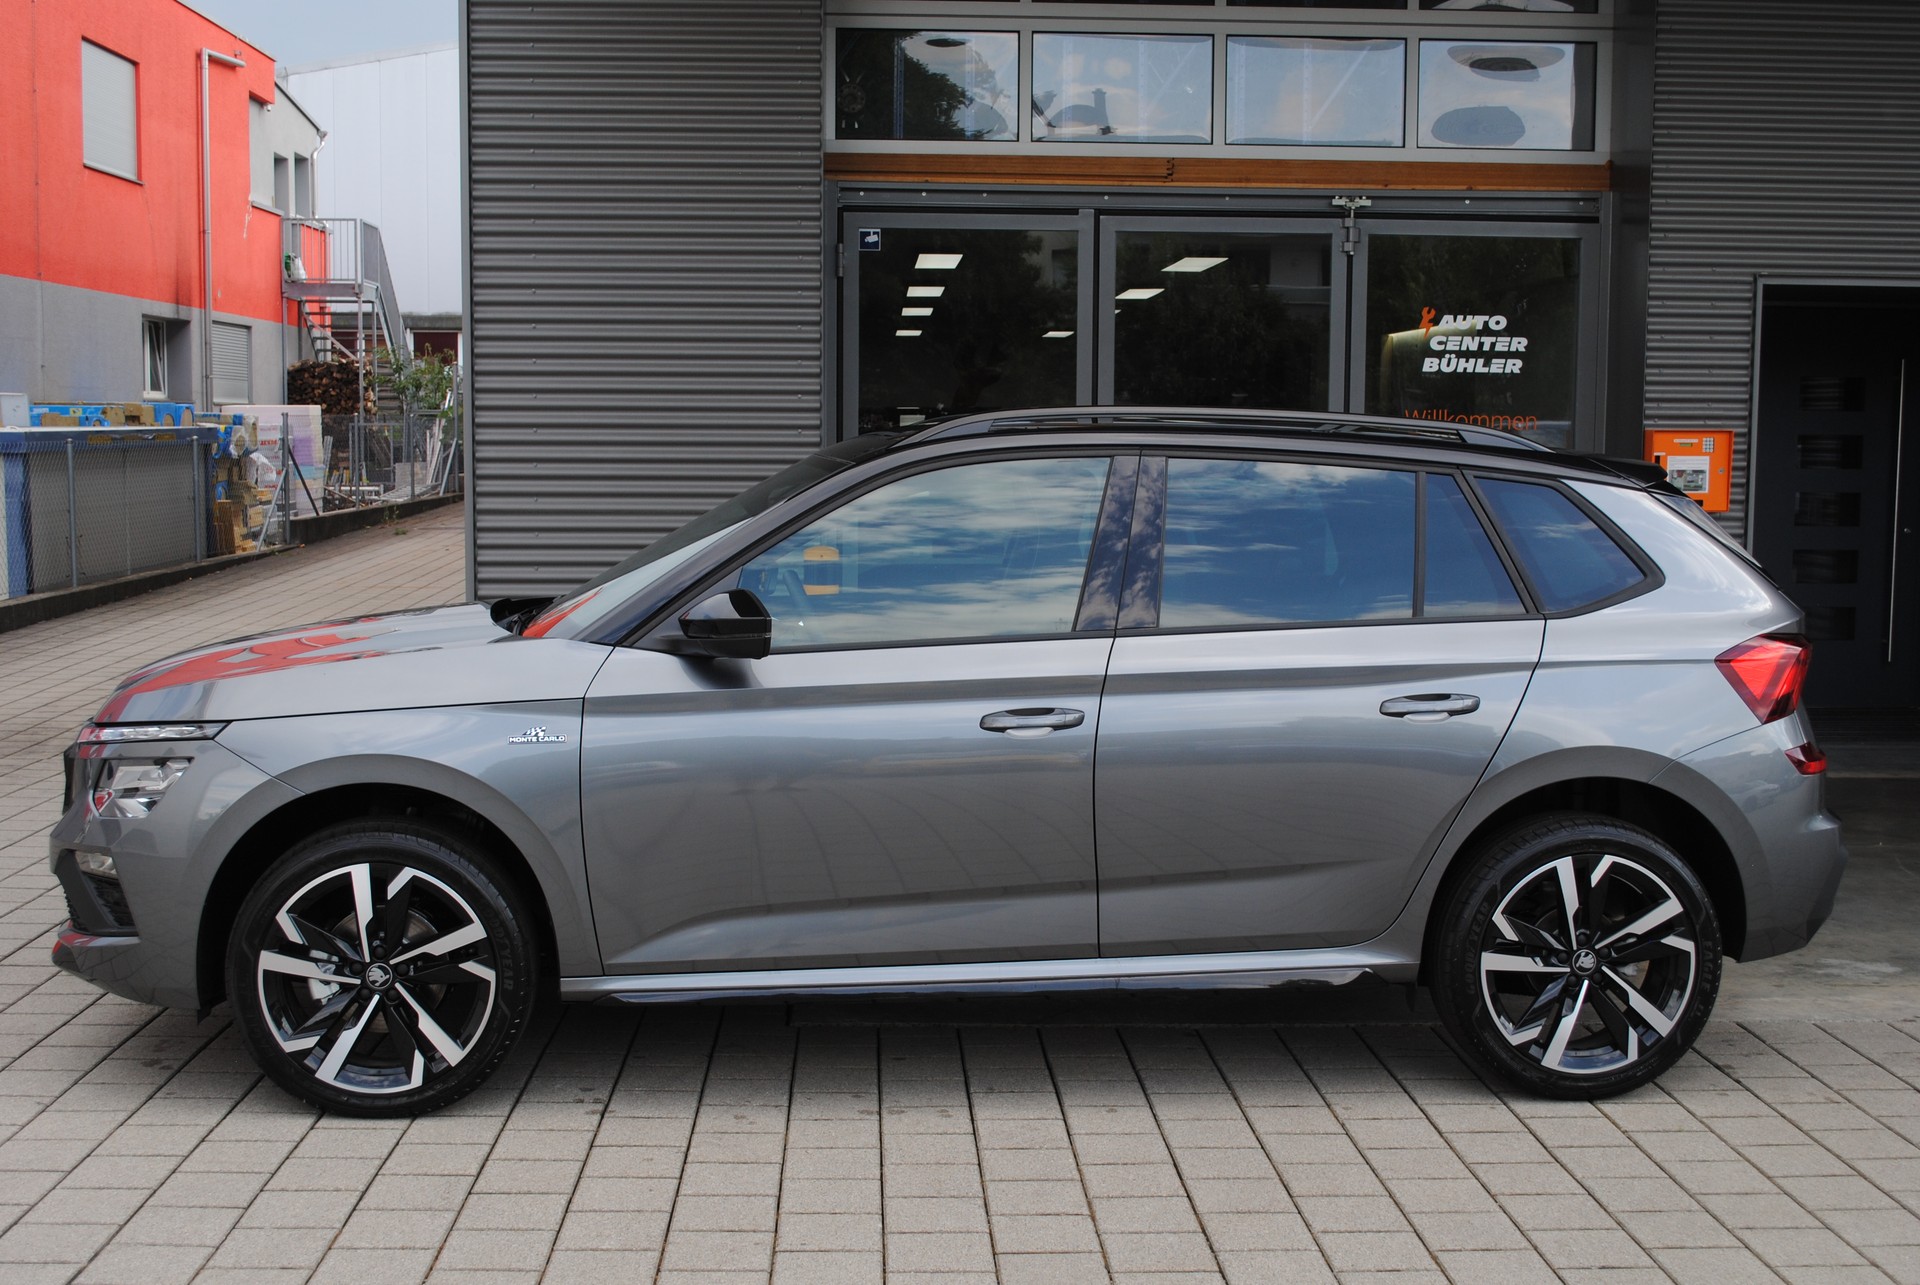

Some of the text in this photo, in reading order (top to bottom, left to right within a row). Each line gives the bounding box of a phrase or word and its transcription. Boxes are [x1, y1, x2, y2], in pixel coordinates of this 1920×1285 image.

[1437, 314, 1508, 331] AUTO
[1429, 335, 1529, 352] CENTER
[1422, 353, 1523, 374] BÜHLER
[1404, 409, 1537, 431] Willkommen
